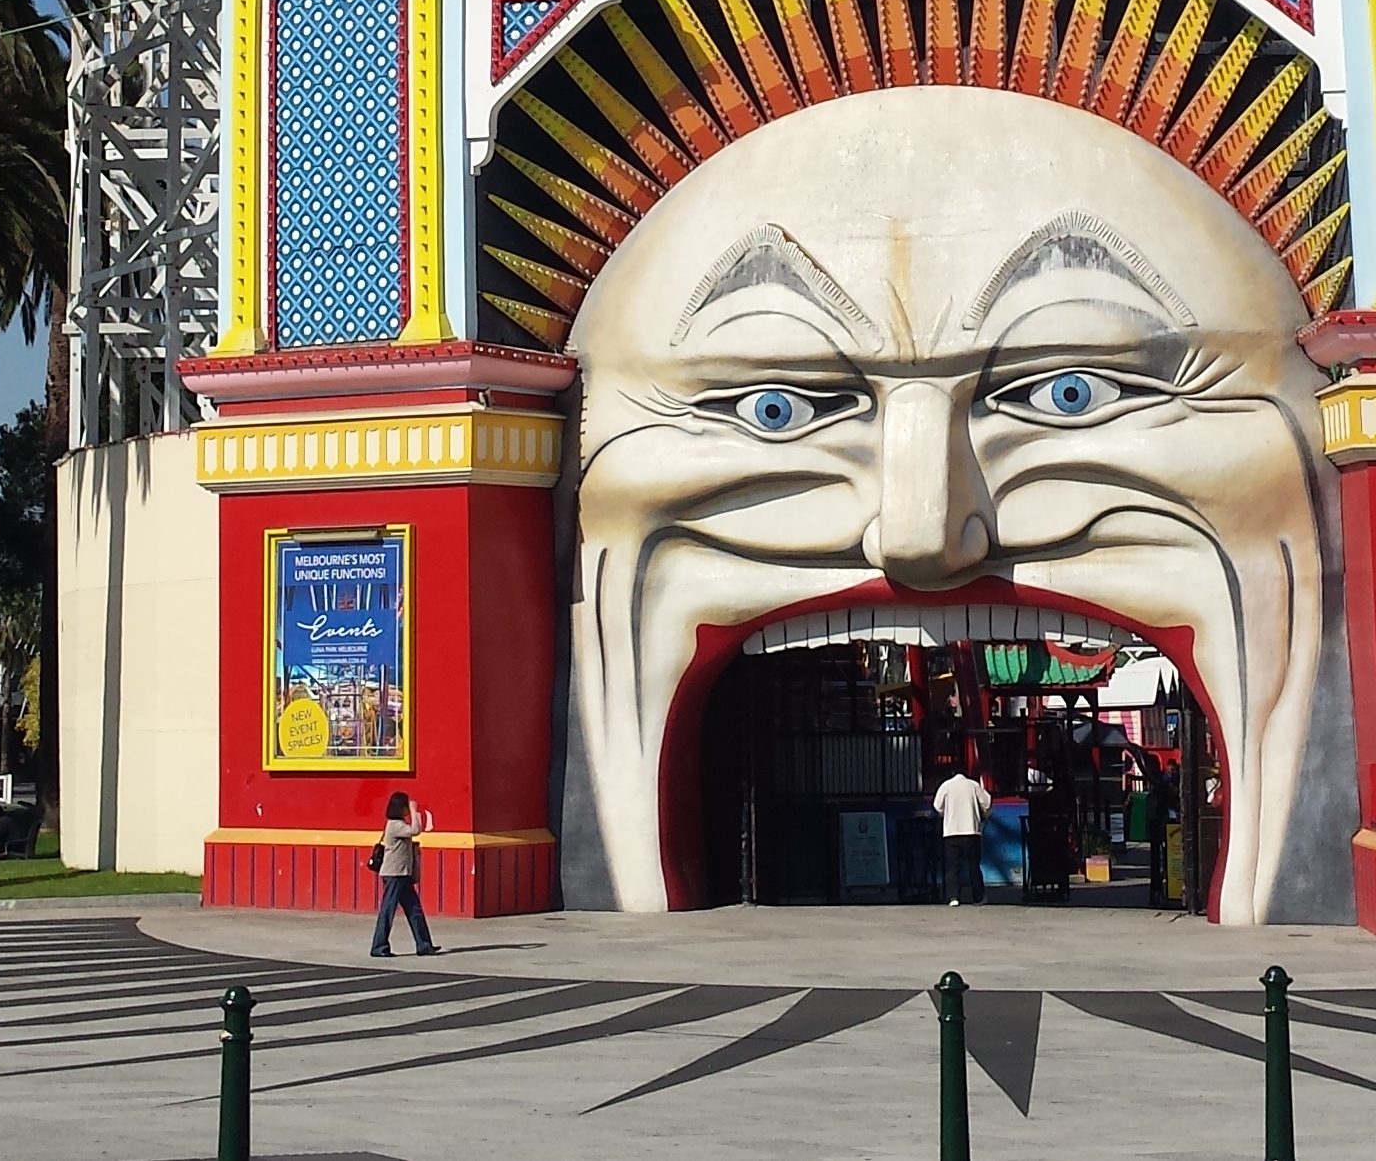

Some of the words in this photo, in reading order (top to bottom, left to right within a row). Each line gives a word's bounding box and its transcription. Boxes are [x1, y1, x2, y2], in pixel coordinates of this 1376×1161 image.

[295, 554, 358, 567] MELBOURNE'S
[359, 553, 386, 565] MOST
[295, 569, 329, 581] UNIQUE
[331, 567, 386, 580] FUNCTIONS!
[297, 614, 384, 641] Events
[292, 709, 312, 722] NEW
[289, 721, 317, 736] EVENT
[288, 734, 323, 751] SPACES!
